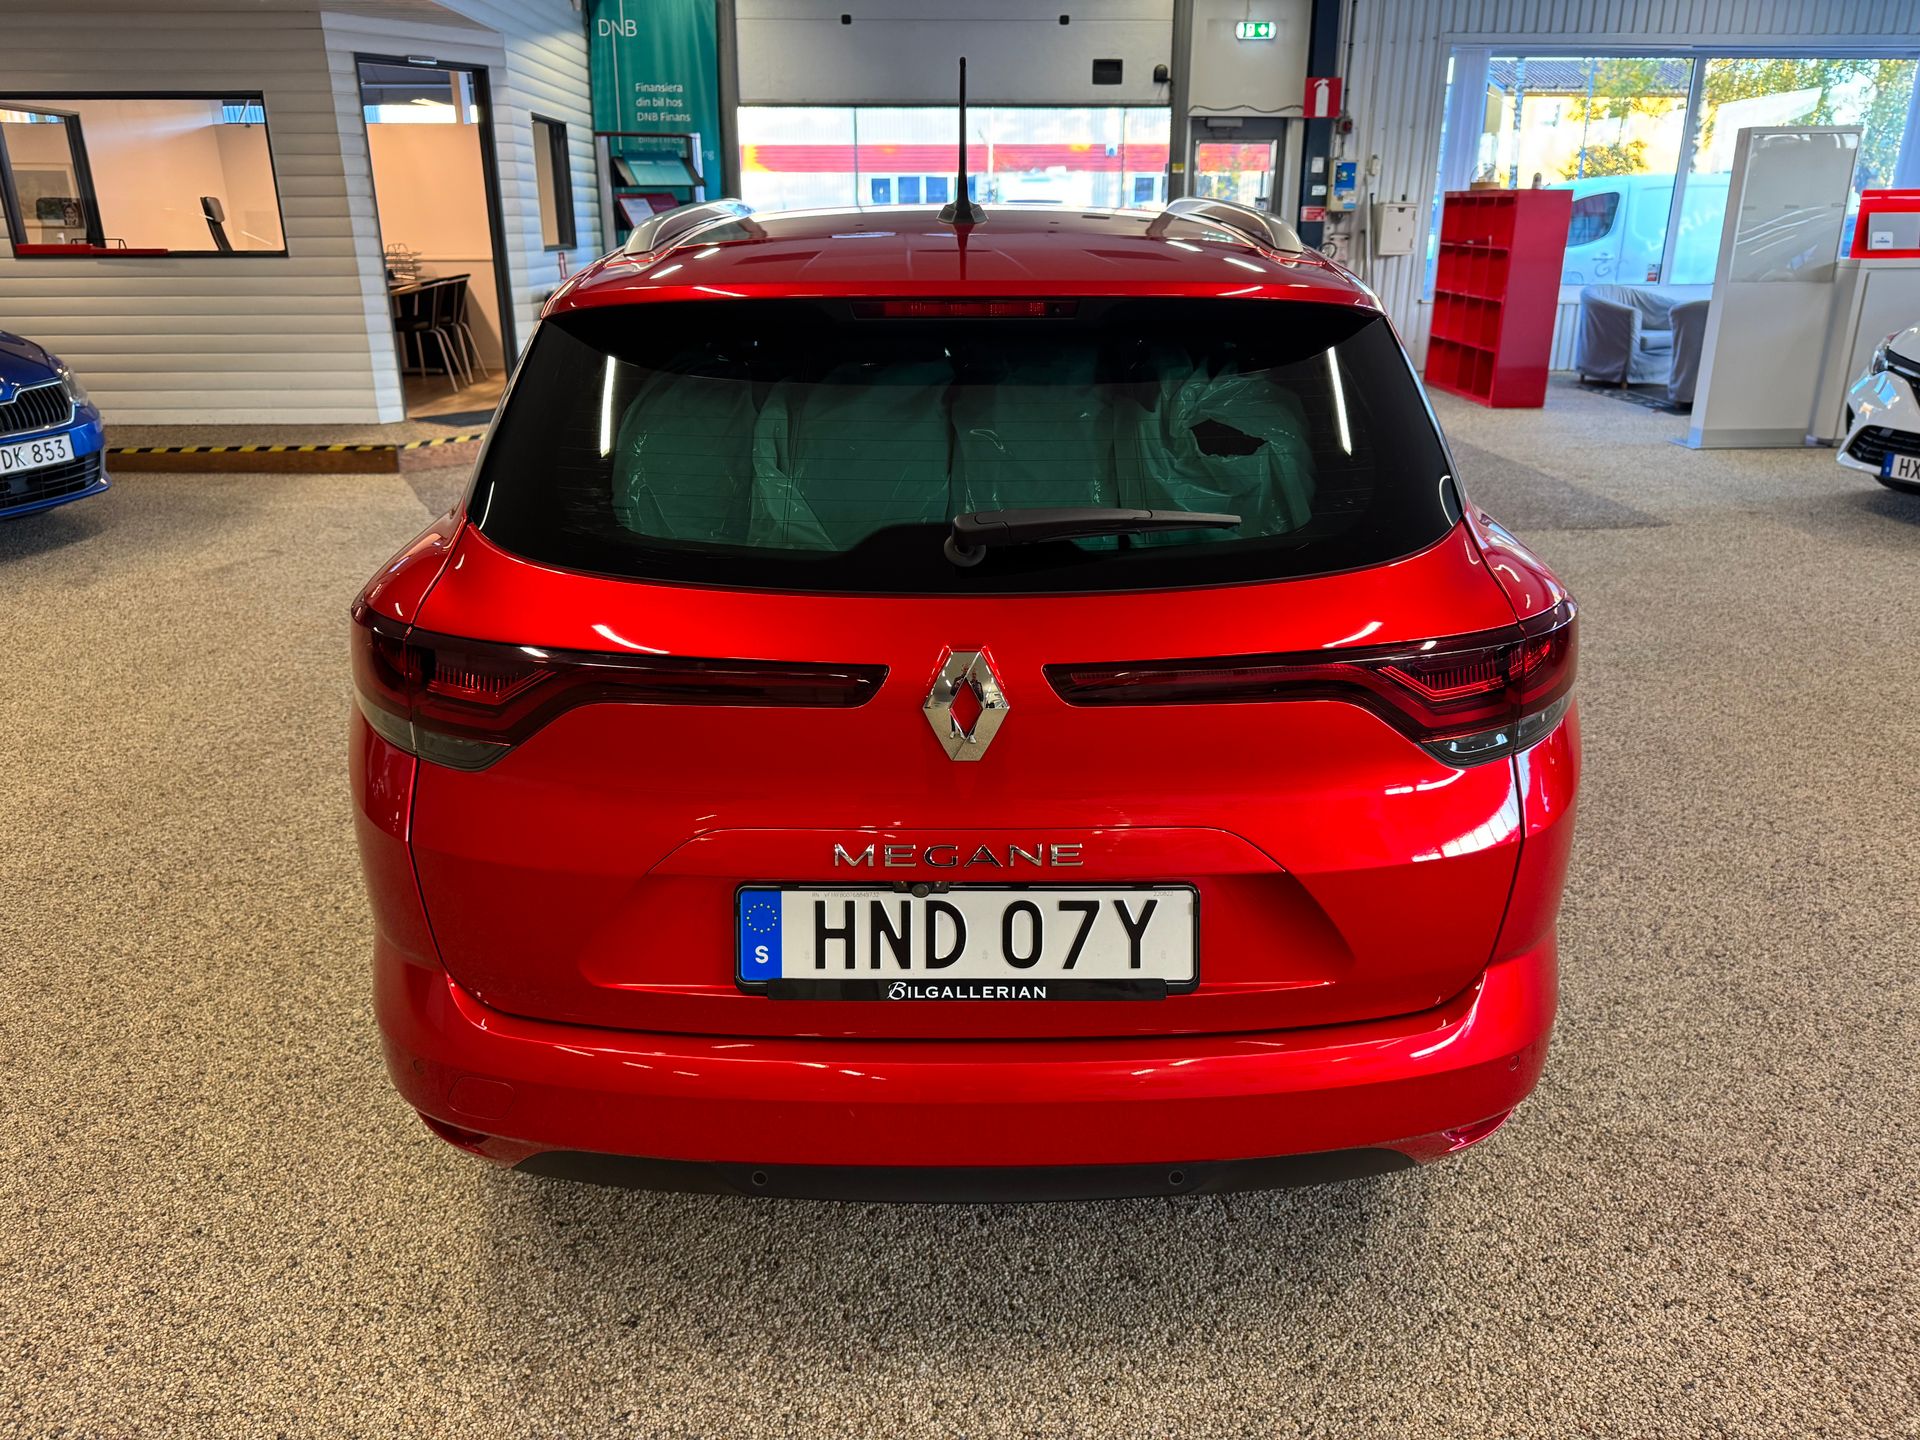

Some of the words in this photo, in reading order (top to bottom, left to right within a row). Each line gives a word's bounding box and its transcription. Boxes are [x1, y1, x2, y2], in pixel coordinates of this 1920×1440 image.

[598, 18, 638, 37] DNB
[635, 82, 683, 92] Finansiera
[636, 97, 651, 107] din
[652, 97, 665, 107] bil
[665, 97, 683, 107] hos
[637, 112, 659, 121] DNB
[660, 112, 691, 122] Finans
[1, 446, 27, 469] DK
[31, 439, 66, 463] 853
[834, 843, 1084, 868] MEGANE
[815, 900, 967, 969] HND
[1002, 900, 1159, 969] 07Y
[755, 946, 769, 965] S
[887, 981, 1047, 1000] BILGALLERIAN
